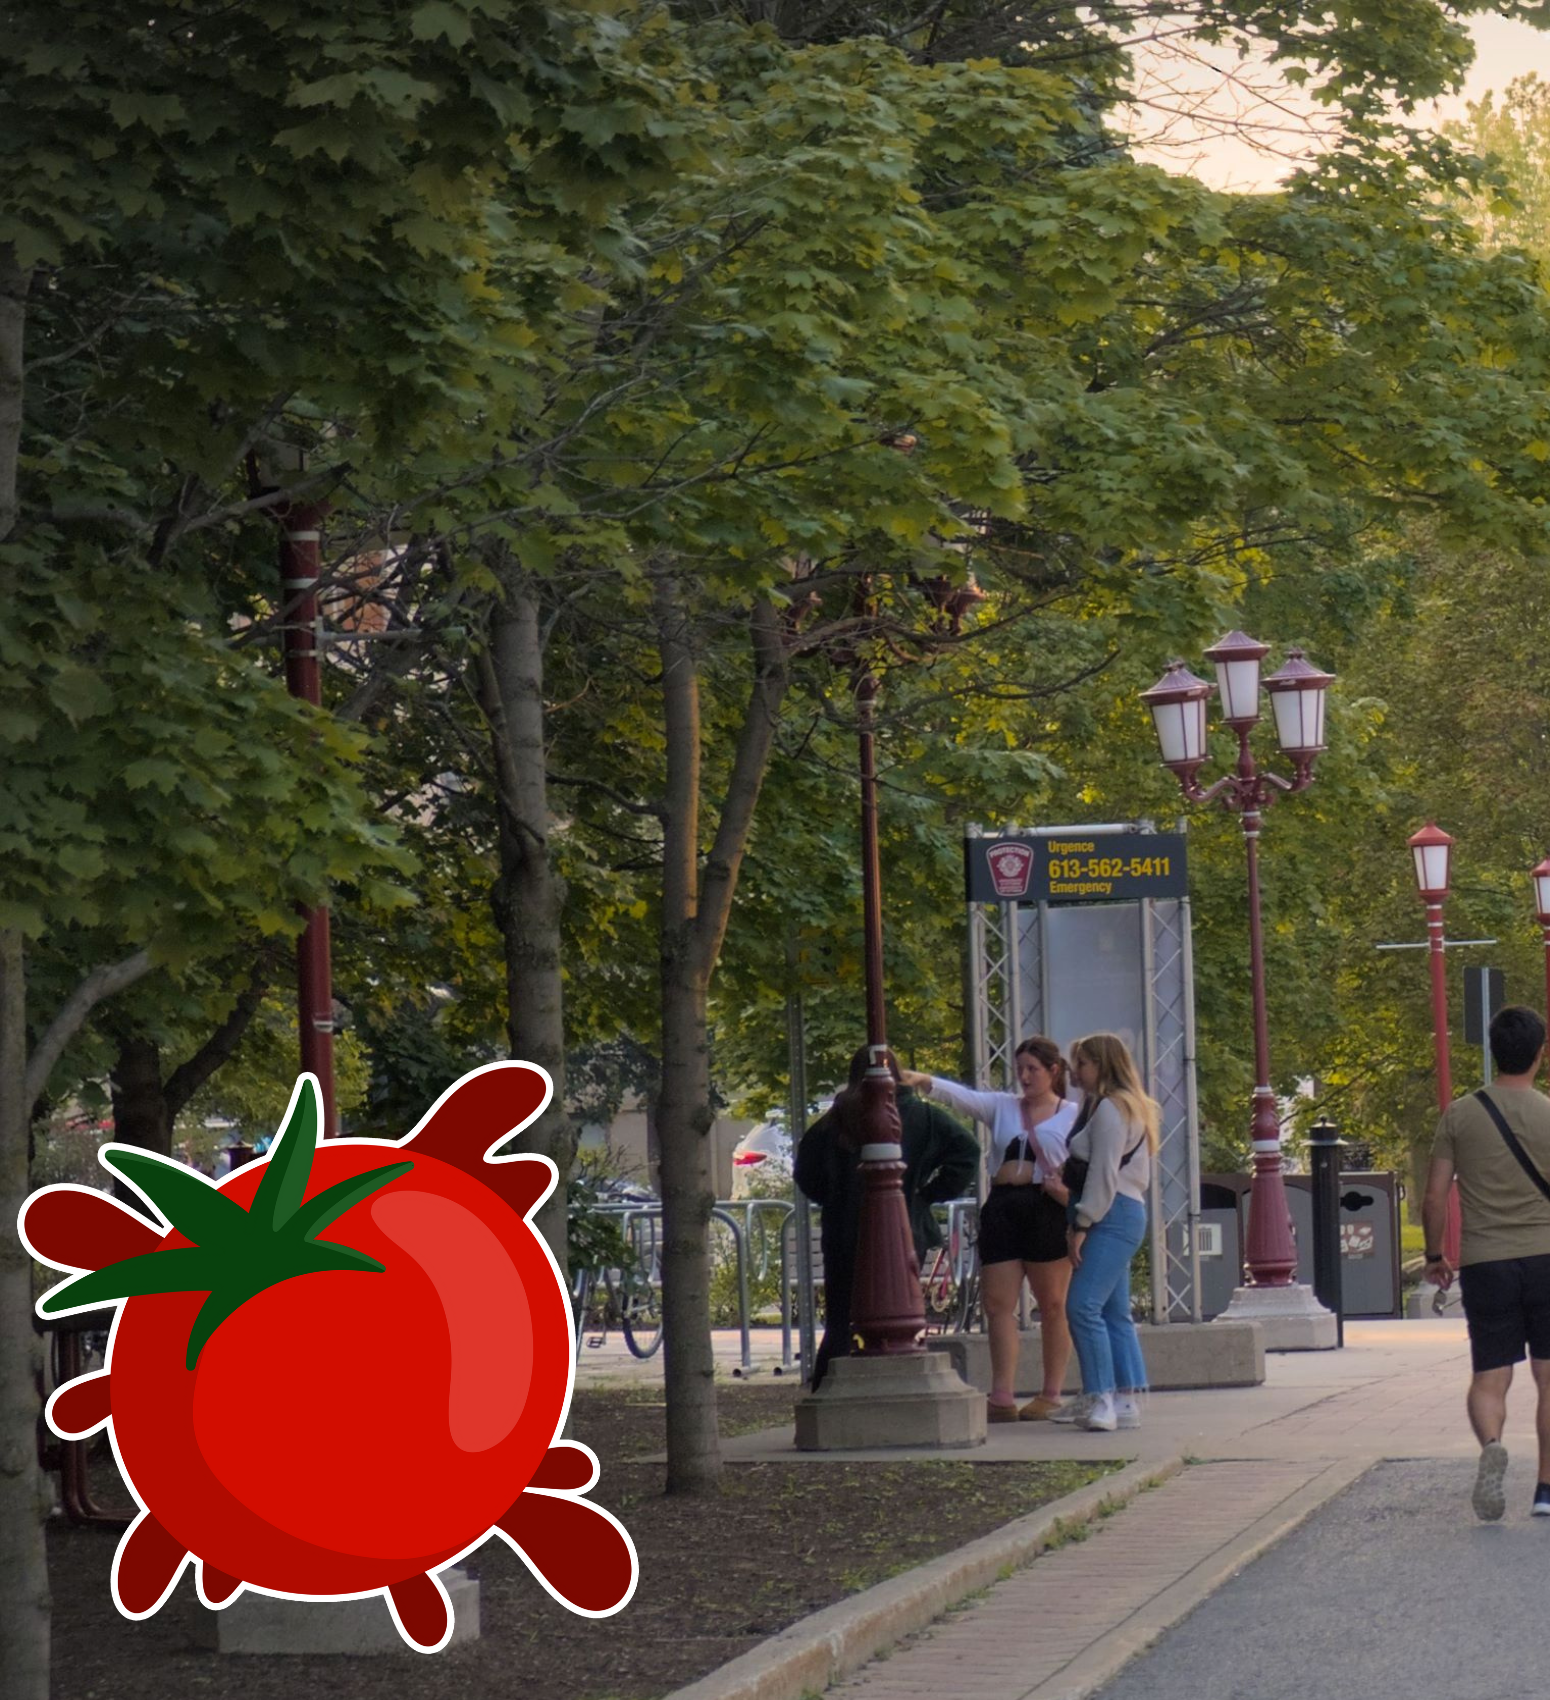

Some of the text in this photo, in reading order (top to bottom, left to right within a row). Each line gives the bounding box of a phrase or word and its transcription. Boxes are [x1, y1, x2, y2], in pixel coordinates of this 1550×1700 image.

[989, 846, 1030, 859] PROTECTION
[1048, 840, 1095, 855] Urgence
[1048, 857, 1170, 879] 613-562-5411
[1049, 881, 1112, 895] Emergency
